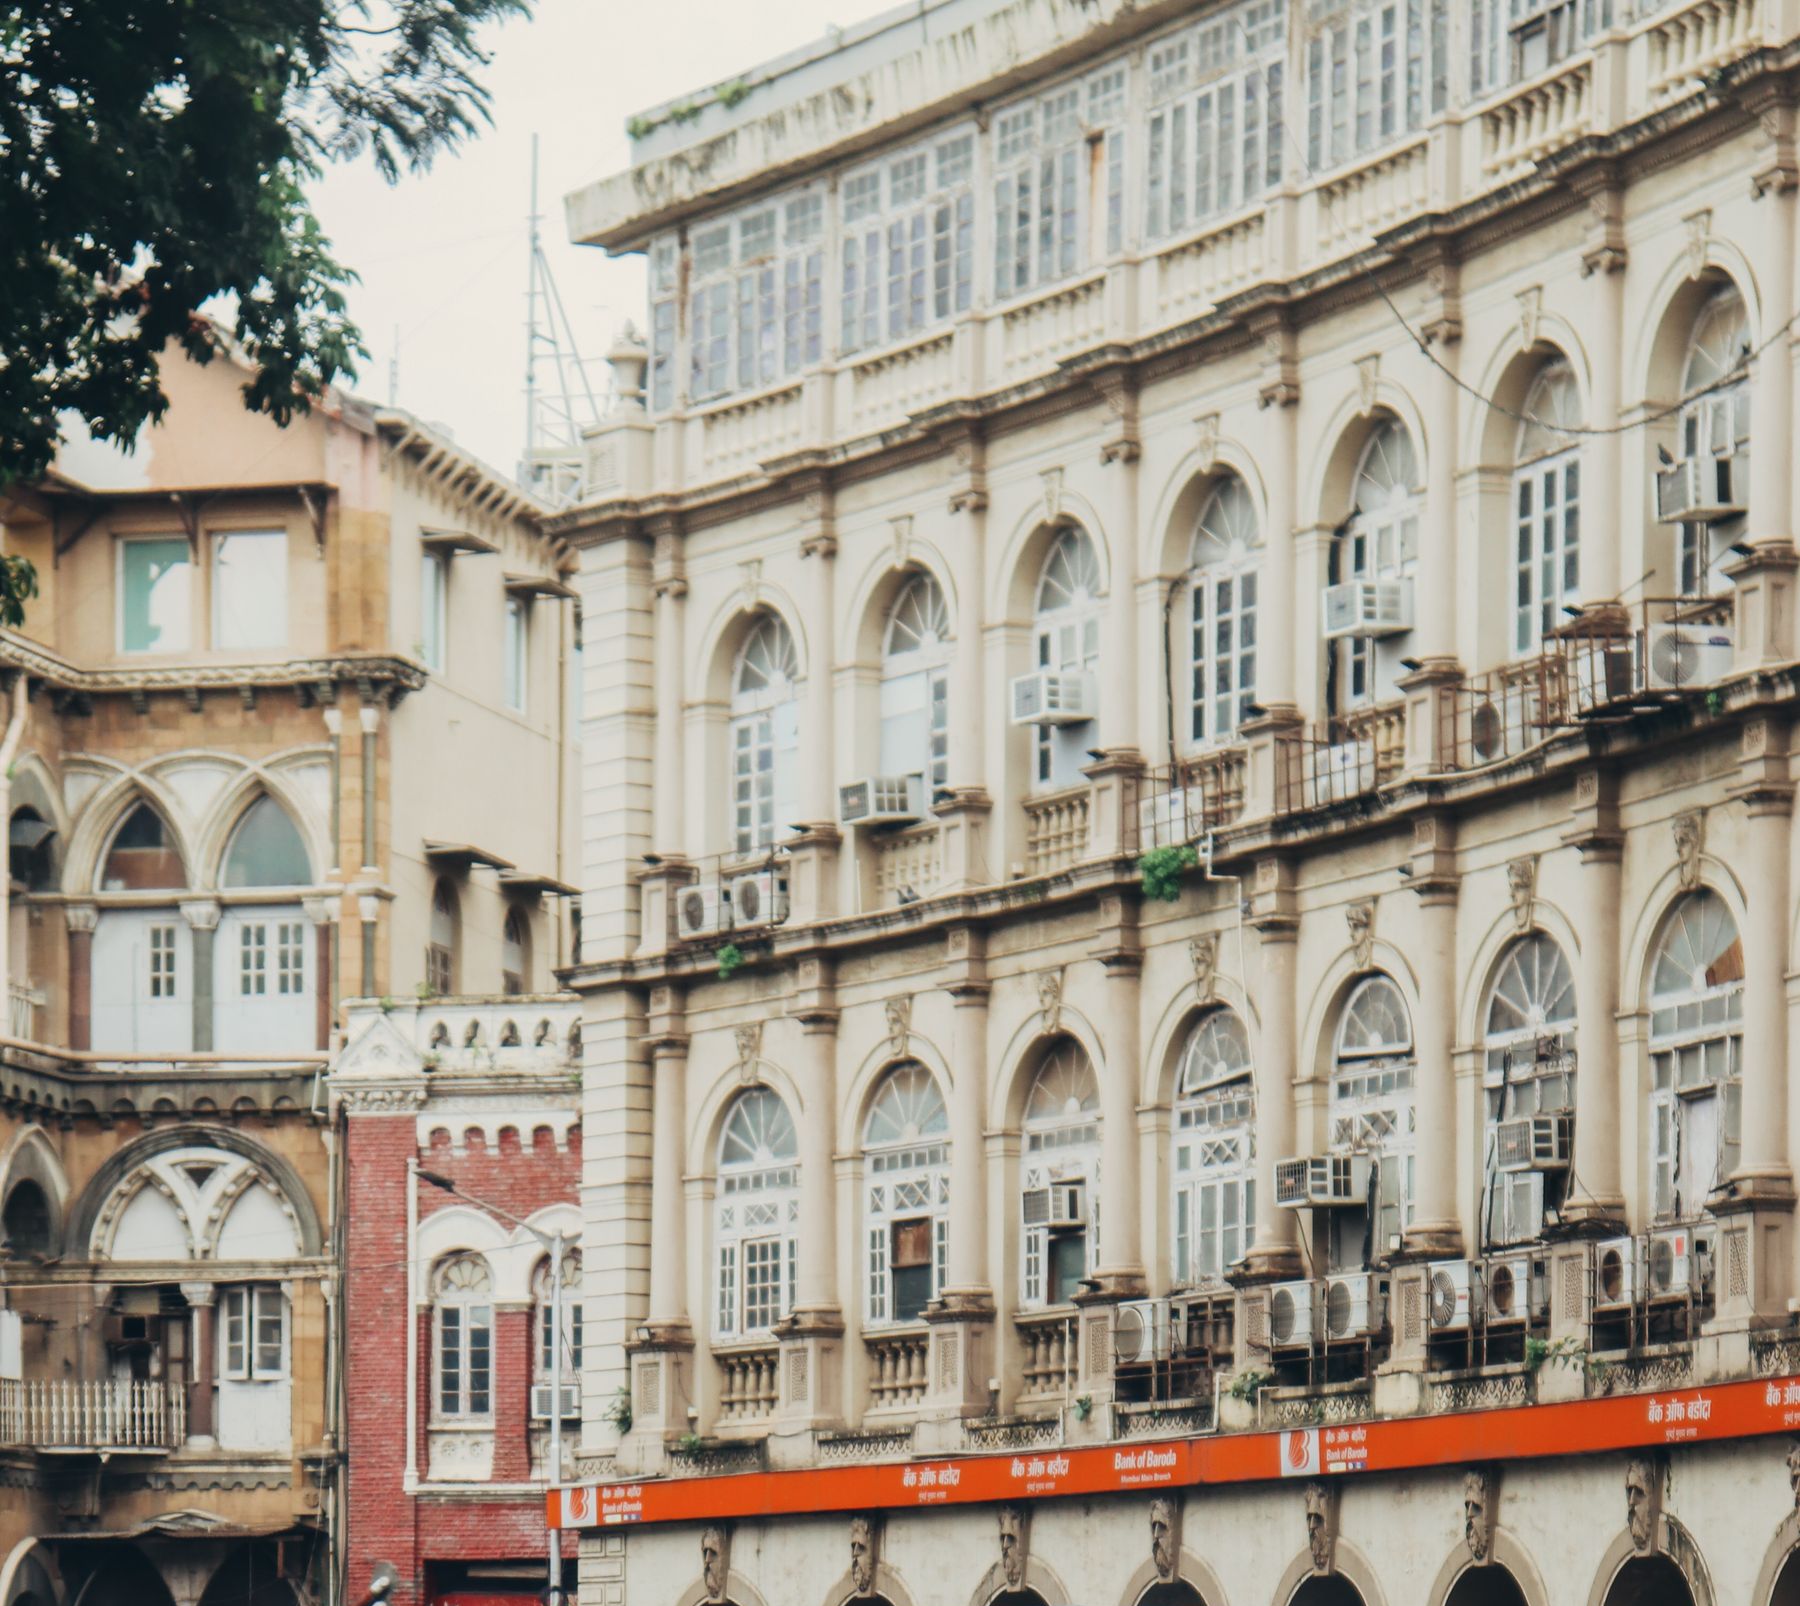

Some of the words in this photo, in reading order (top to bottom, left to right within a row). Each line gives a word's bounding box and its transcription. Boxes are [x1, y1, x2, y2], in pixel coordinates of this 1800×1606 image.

[1114, 1451, 1136, 1470] Bank
[1137, 1450, 1146, 1469] of
[1147, 1448, 1176, 1468] Baroda
